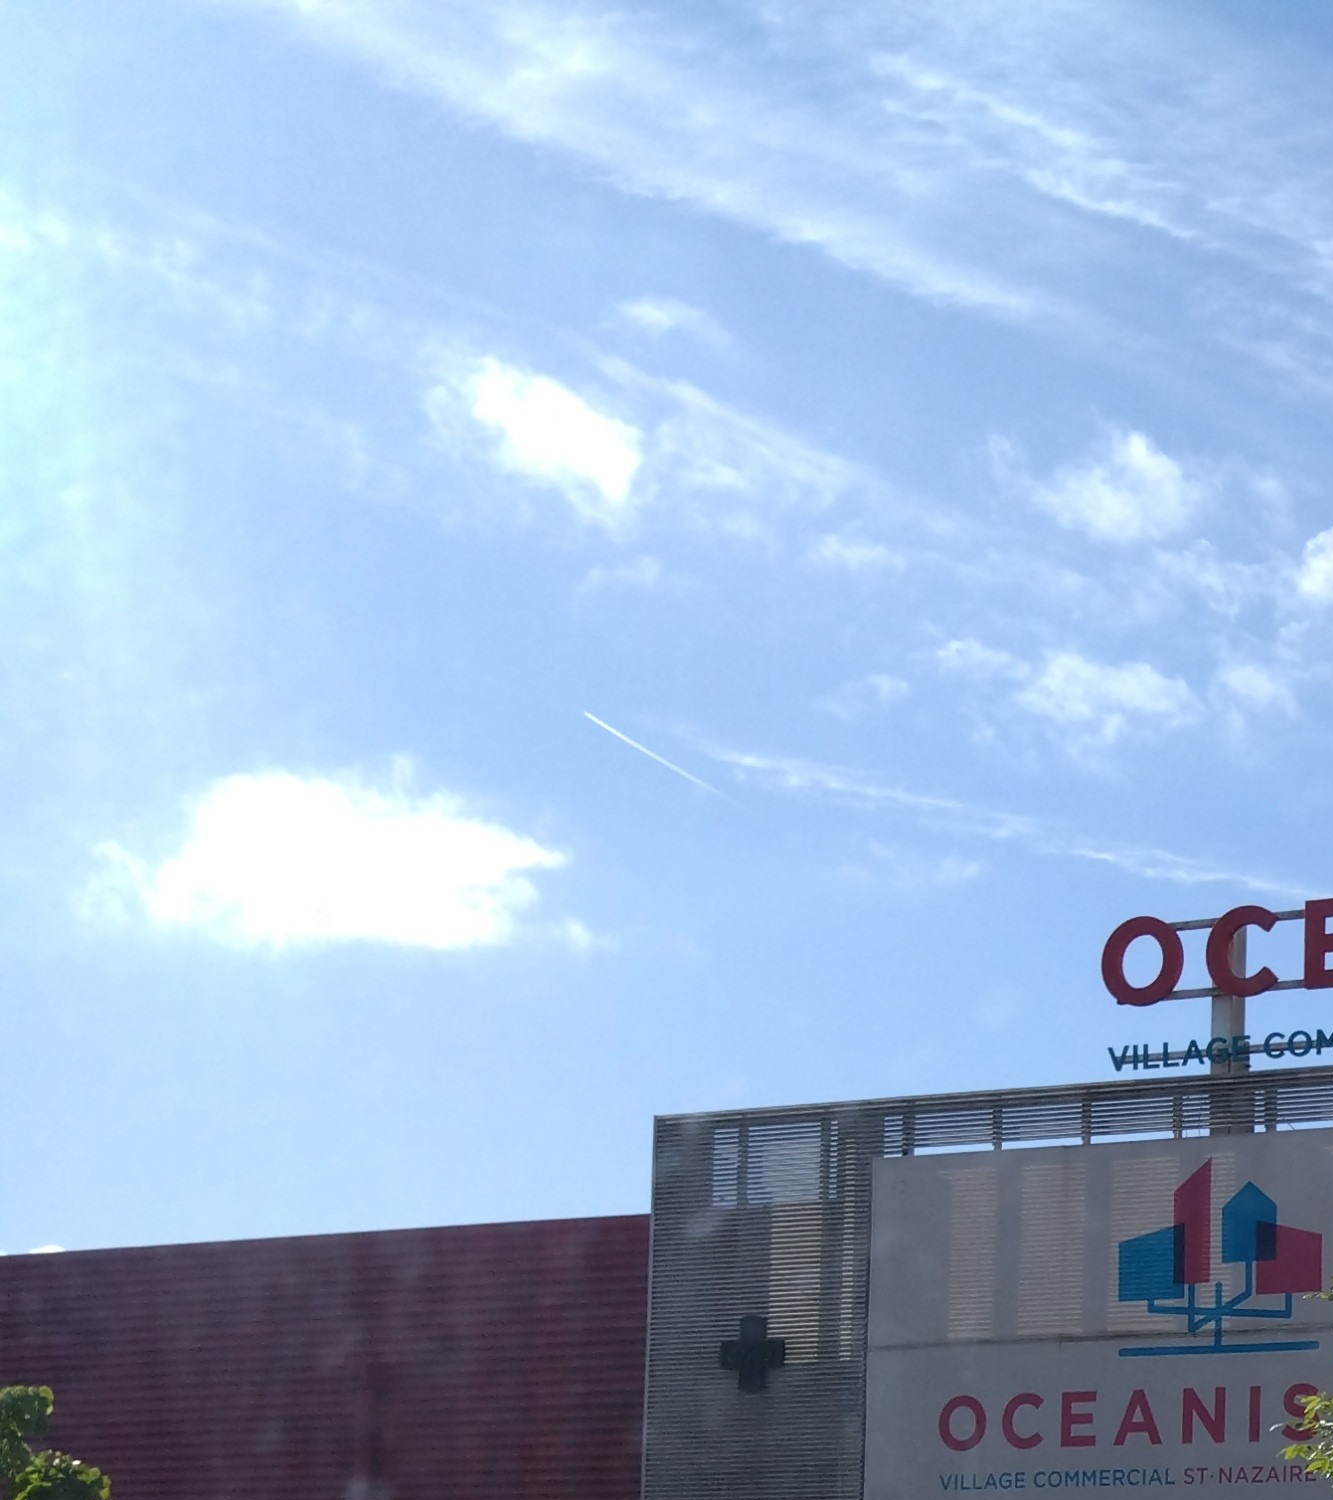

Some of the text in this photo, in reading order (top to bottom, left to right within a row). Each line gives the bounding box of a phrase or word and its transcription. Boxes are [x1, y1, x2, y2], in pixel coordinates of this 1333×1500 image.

[1108, 1035, 1250, 1071] VILLAGE
[938, 1383, 1321, 1452] OCEANIS
[939, 1471, 1026, 1491] VILLAGE
[1033, 1467, 1175, 1489] COMMERCIAL
